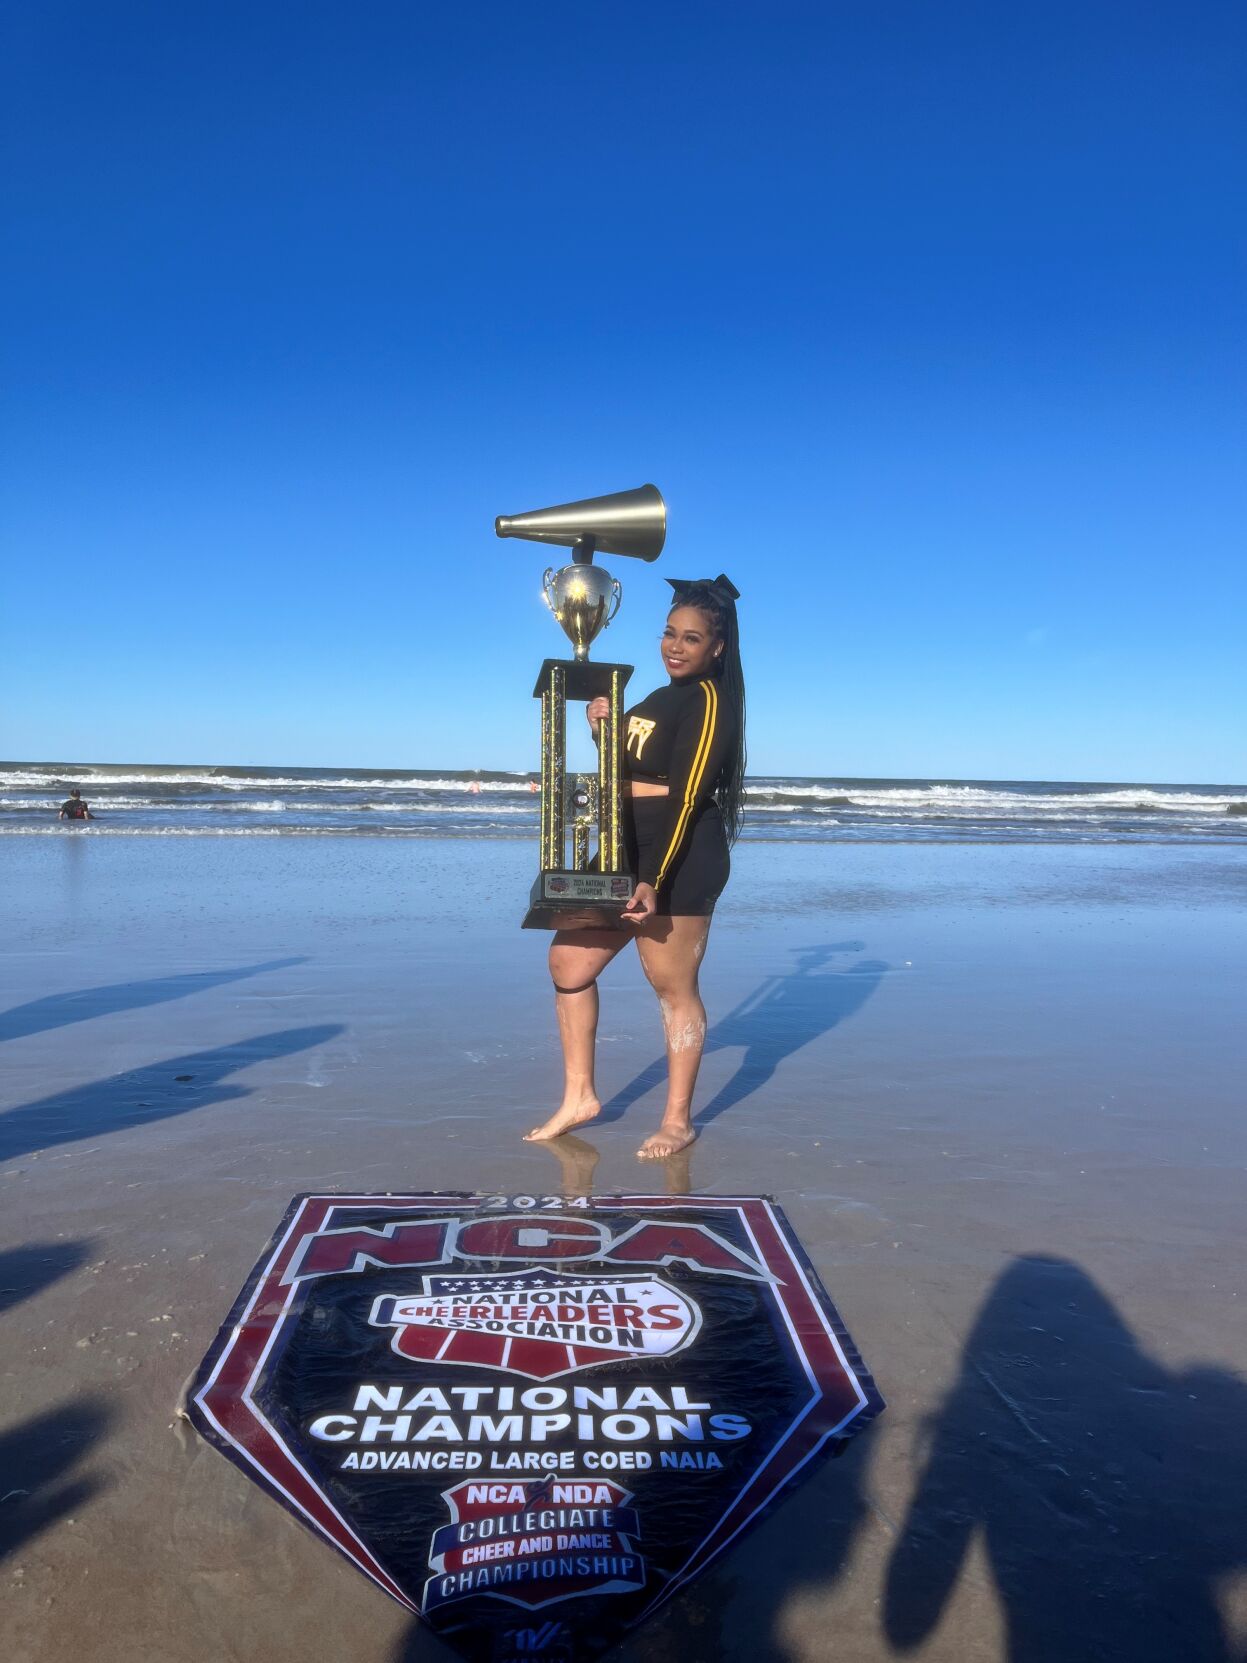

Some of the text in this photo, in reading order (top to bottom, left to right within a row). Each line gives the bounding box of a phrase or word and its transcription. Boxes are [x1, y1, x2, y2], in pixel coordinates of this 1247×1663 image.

[577, 887, 602, 896] CHAMPIONS
[585, 879, 606, 888] NATIONAL
[487, 1196, 590, 1209] 2024
[279, 1214, 788, 1287] NCA
[451, 1287, 638, 1305] NATIONAL
[399, 1304, 684, 1331] CHEERLEADERS
[428, 1318, 645, 1348] ASSOCIATION
[353, 1385, 711, 1411] NATIONAL
[309, 1414, 752, 1441] CHAMPIONS
[340, 1451, 724, 1470] ADVANCED LARGE COED NAIA
[466, 1485, 613, 1504] NCA NDA
[459, 1509, 614, 1543] COLLEGIATE
[462, 1533, 613, 1565] CHEER AND DANCE
[441, 1556, 634, 1597] CHAMPIONSHIP
